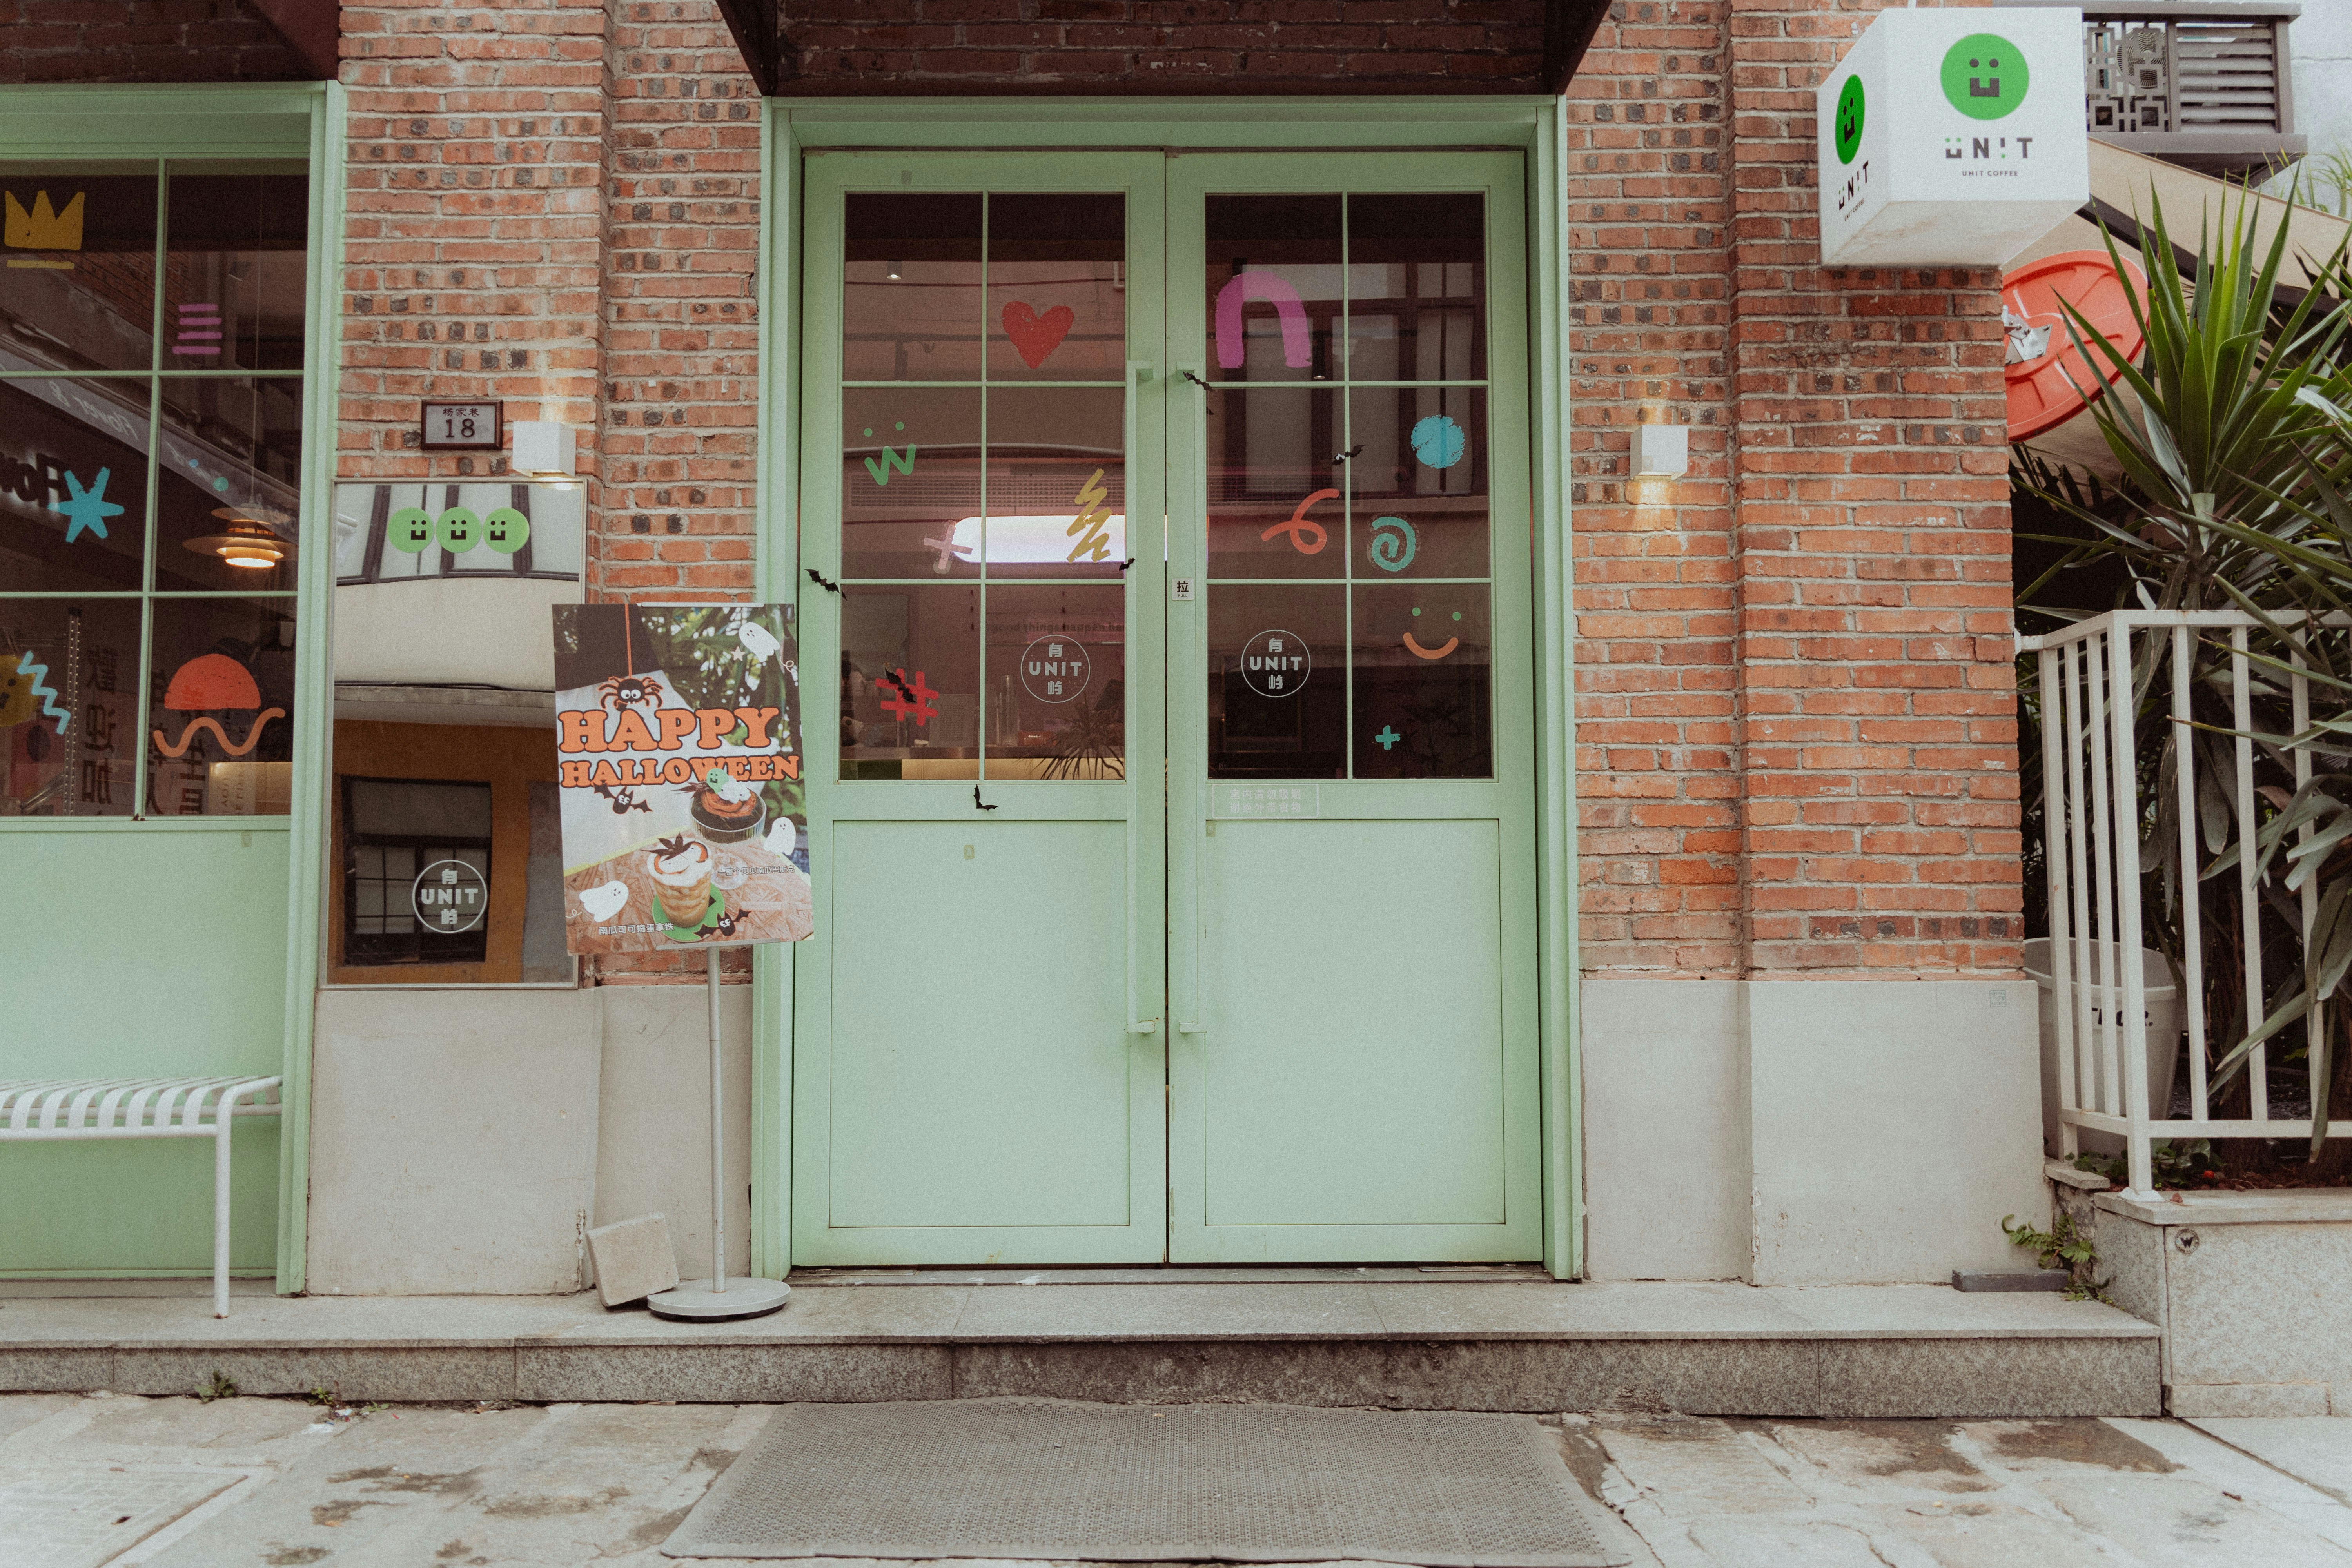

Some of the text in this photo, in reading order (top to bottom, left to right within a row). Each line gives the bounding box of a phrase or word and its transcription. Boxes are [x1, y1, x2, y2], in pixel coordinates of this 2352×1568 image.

[442, 407, 480, 417] 杨家巷
[445, 418, 475, 438] 18
[1177, 581, 1189, 593] 拉
[1029, 661, 1082, 677] UNIT
[1250, 656, 1302, 671] UNIT
[558, 707, 780, 753] HAPPY
[560, 755, 800, 788] HALLOWEEN
[1230, 789, 1301, 800] 室内请勿吸烟
[1230, 802, 1301, 813] 谢绝外带食物
[421, 888, 478, 905] UNIT
[599, 922, 674, 935] 南瓜可可捣蛋拿铁
